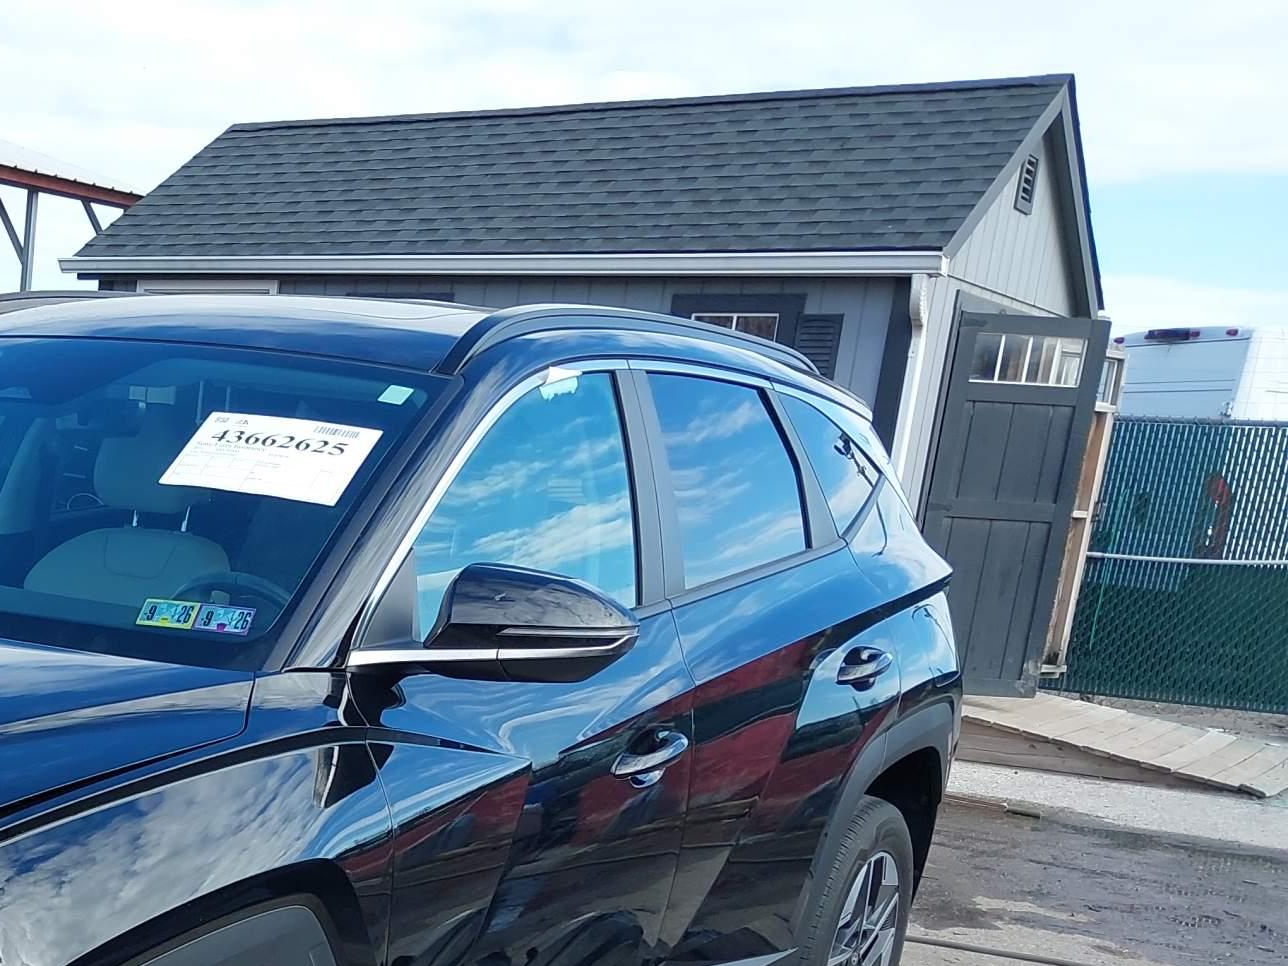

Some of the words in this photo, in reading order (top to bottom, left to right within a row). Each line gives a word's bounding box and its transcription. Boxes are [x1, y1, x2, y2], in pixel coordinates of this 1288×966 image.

[211, 428, 350, 457] 43662625
[175, 605, 195, 624] 26
[233, 611, 252, 630] 26
